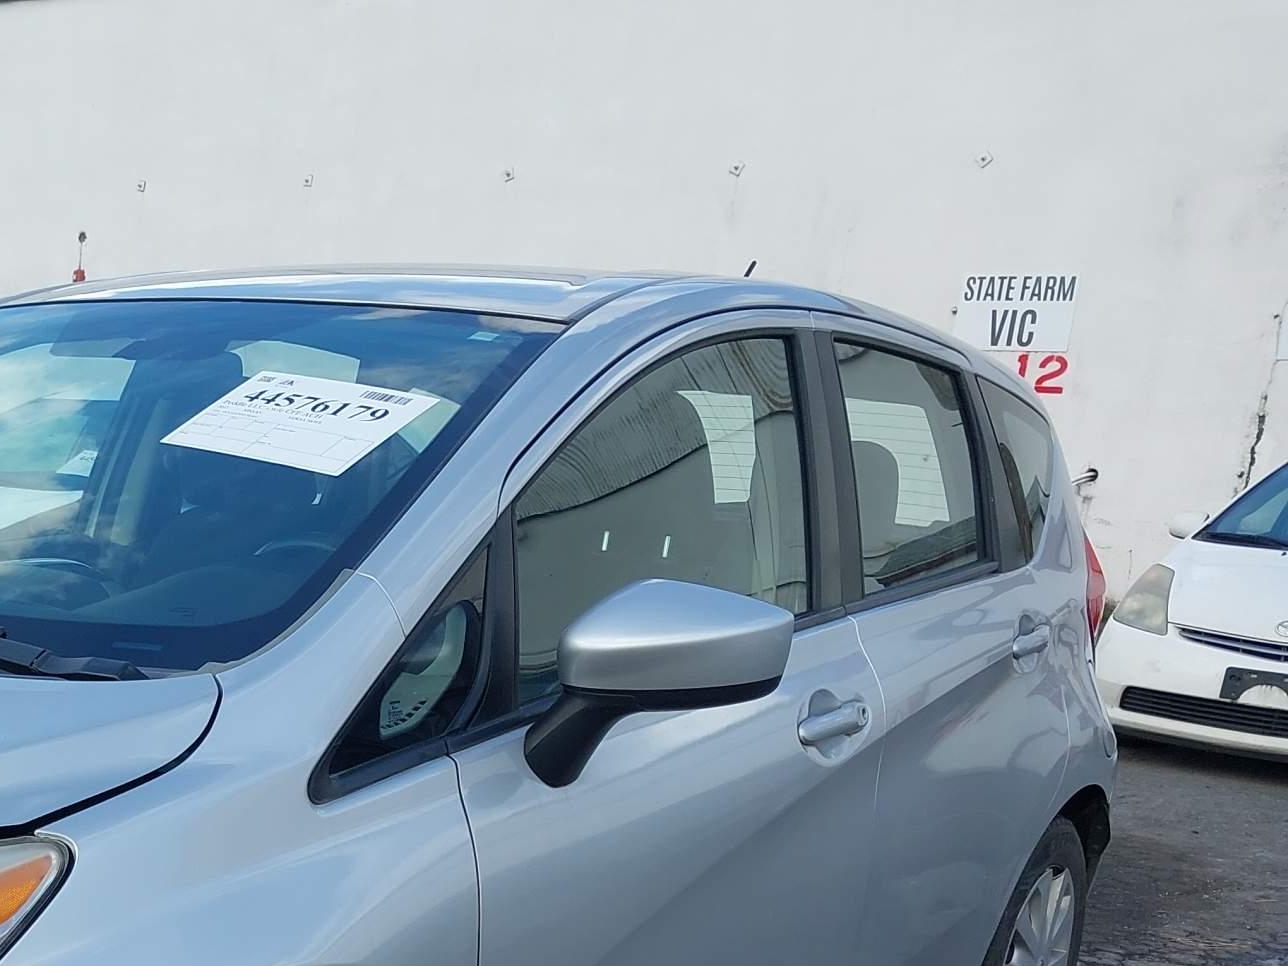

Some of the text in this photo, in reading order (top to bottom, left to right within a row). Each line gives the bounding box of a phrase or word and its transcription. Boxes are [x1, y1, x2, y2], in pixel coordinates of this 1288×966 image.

[964, 276, 1077, 302] STATE FARM
[990, 308, 1038, 347] VIC
[1017, 353, 1069, 394] 12
[244, 389, 390, 423] 44576179
